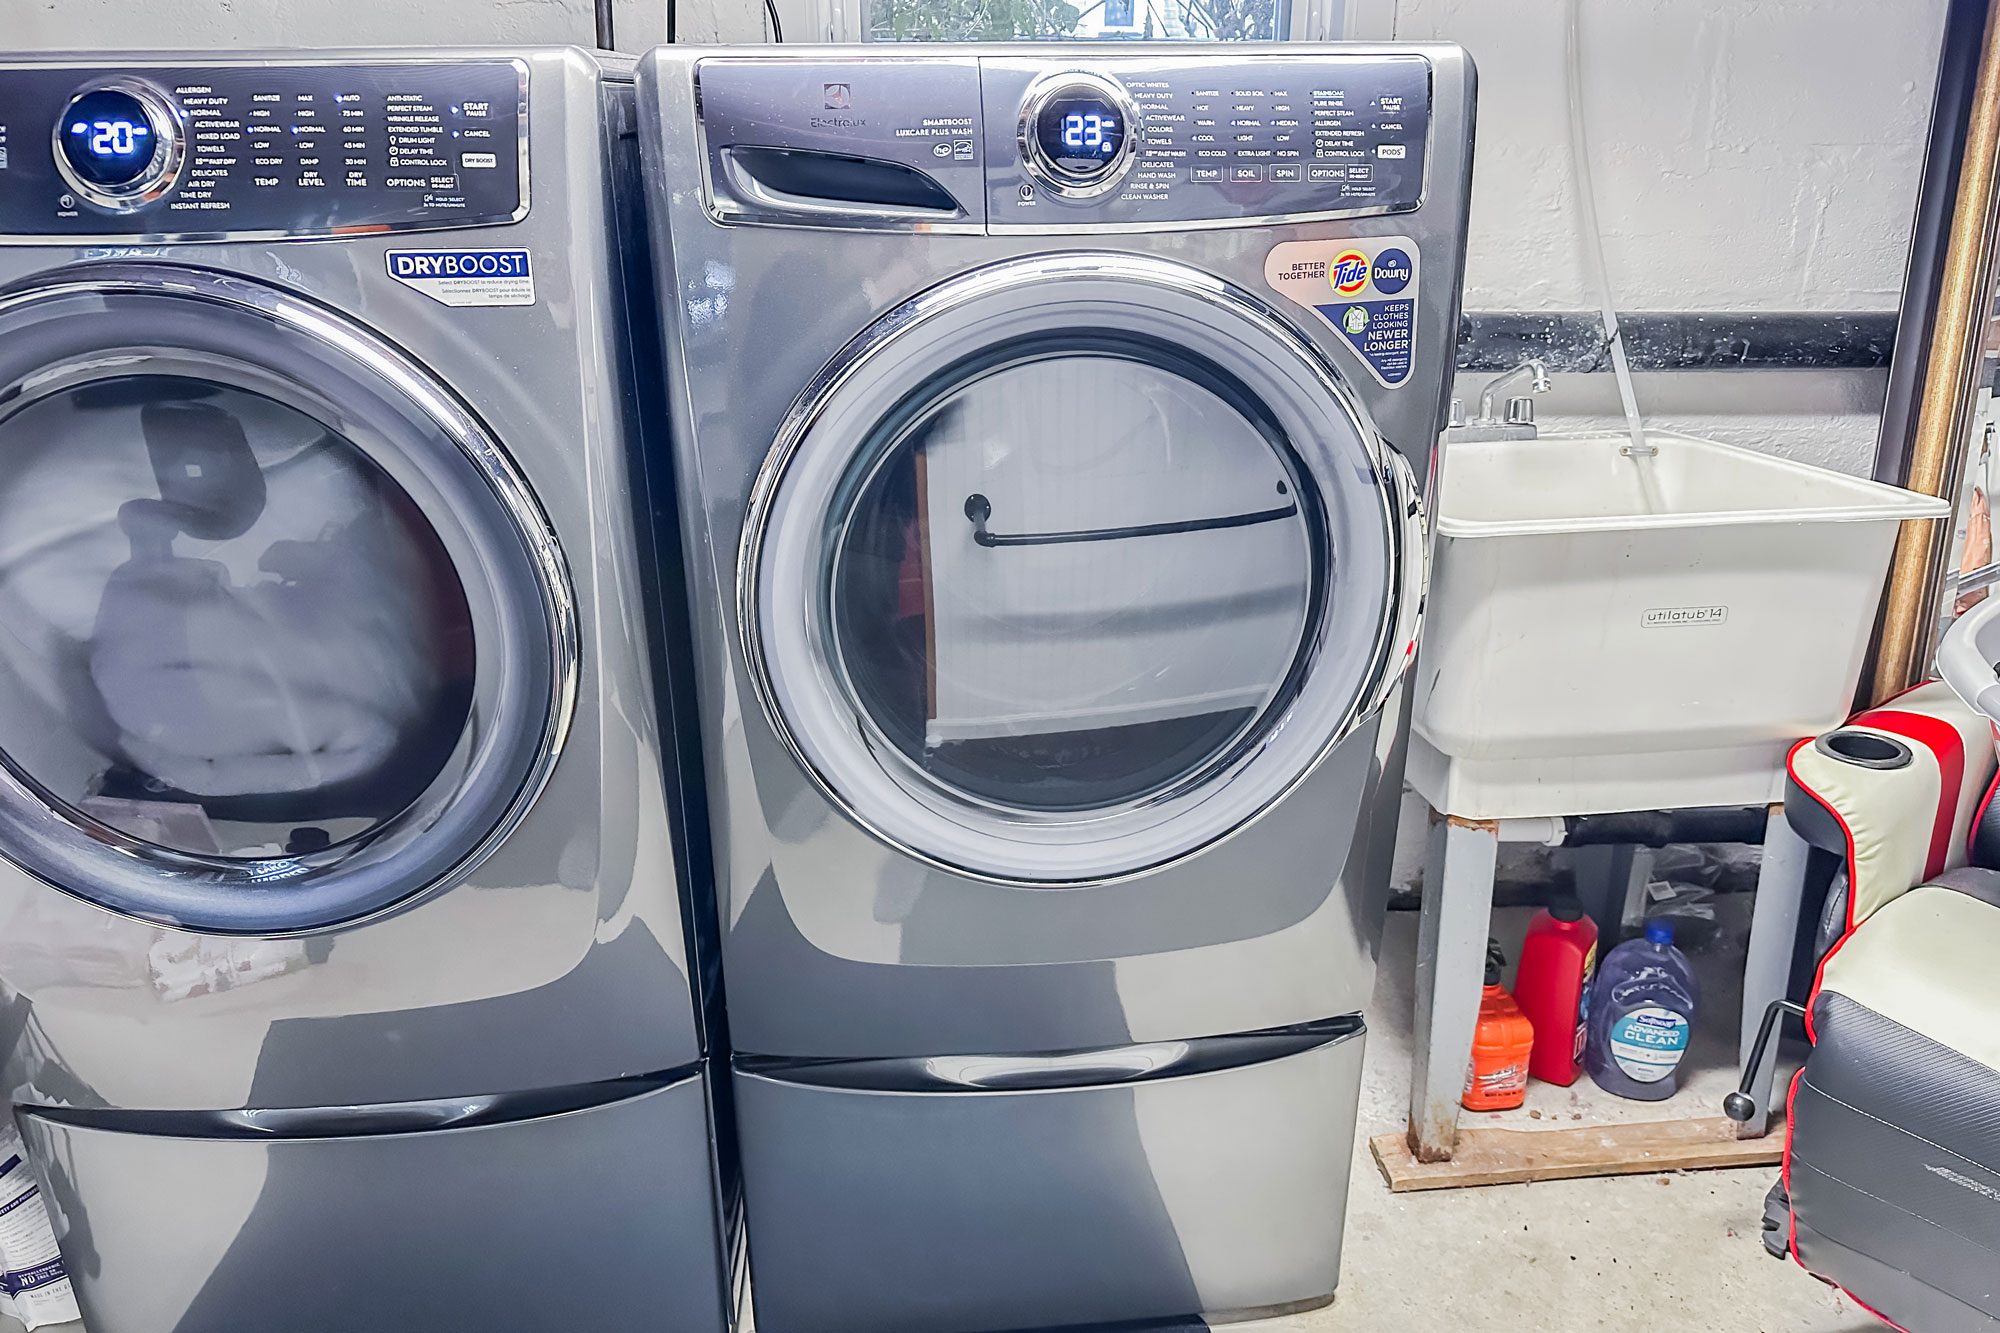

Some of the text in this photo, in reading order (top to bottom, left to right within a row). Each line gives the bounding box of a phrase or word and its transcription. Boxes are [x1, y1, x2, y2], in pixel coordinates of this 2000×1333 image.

[810, 118, 866, 127] Electrolux
[896, 129, 929, 137] LUXCARE
[1066, 116, 1102, 145] 23
[93, 122, 134, 154] 20
[1196, 170, 1218, 178] TEMP
[1238, 170, 1255, 178] SOIL
[254, 178, 279, 186] TEMP
[298, 178, 325, 186] LEVEL
[346, 178, 367, 186] TIME
[387, 179, 426, 187] OPTIONS
[170, 202, 230, 210] INSTANT REFRESH
[397, 255, 523, 275] DRYBOOST
[1292, 262, 1325, 270] BETTER
[1278, 271, 1325, 280] TOGETHER
[1333, 260, 1367, 289] Tide
[1374, 268, 1408, 280] Downy
[1384, 304, 1409, 312] KEEPS
[1374, 312, 1408, 320] CLOTHES
[1373, 321, 1408, 329] LOOKING
[1368, 330, 1408, 340] NEWER
[1364, 339, 1408, 351] LONGER
[1710, 608, 1721, 617] 14
[1627, 1024, 1680, 1037] ADVANCED
[1624, 1031, 1678, 1045] CLEAN
[20, 1275, 35, 1287] NO
